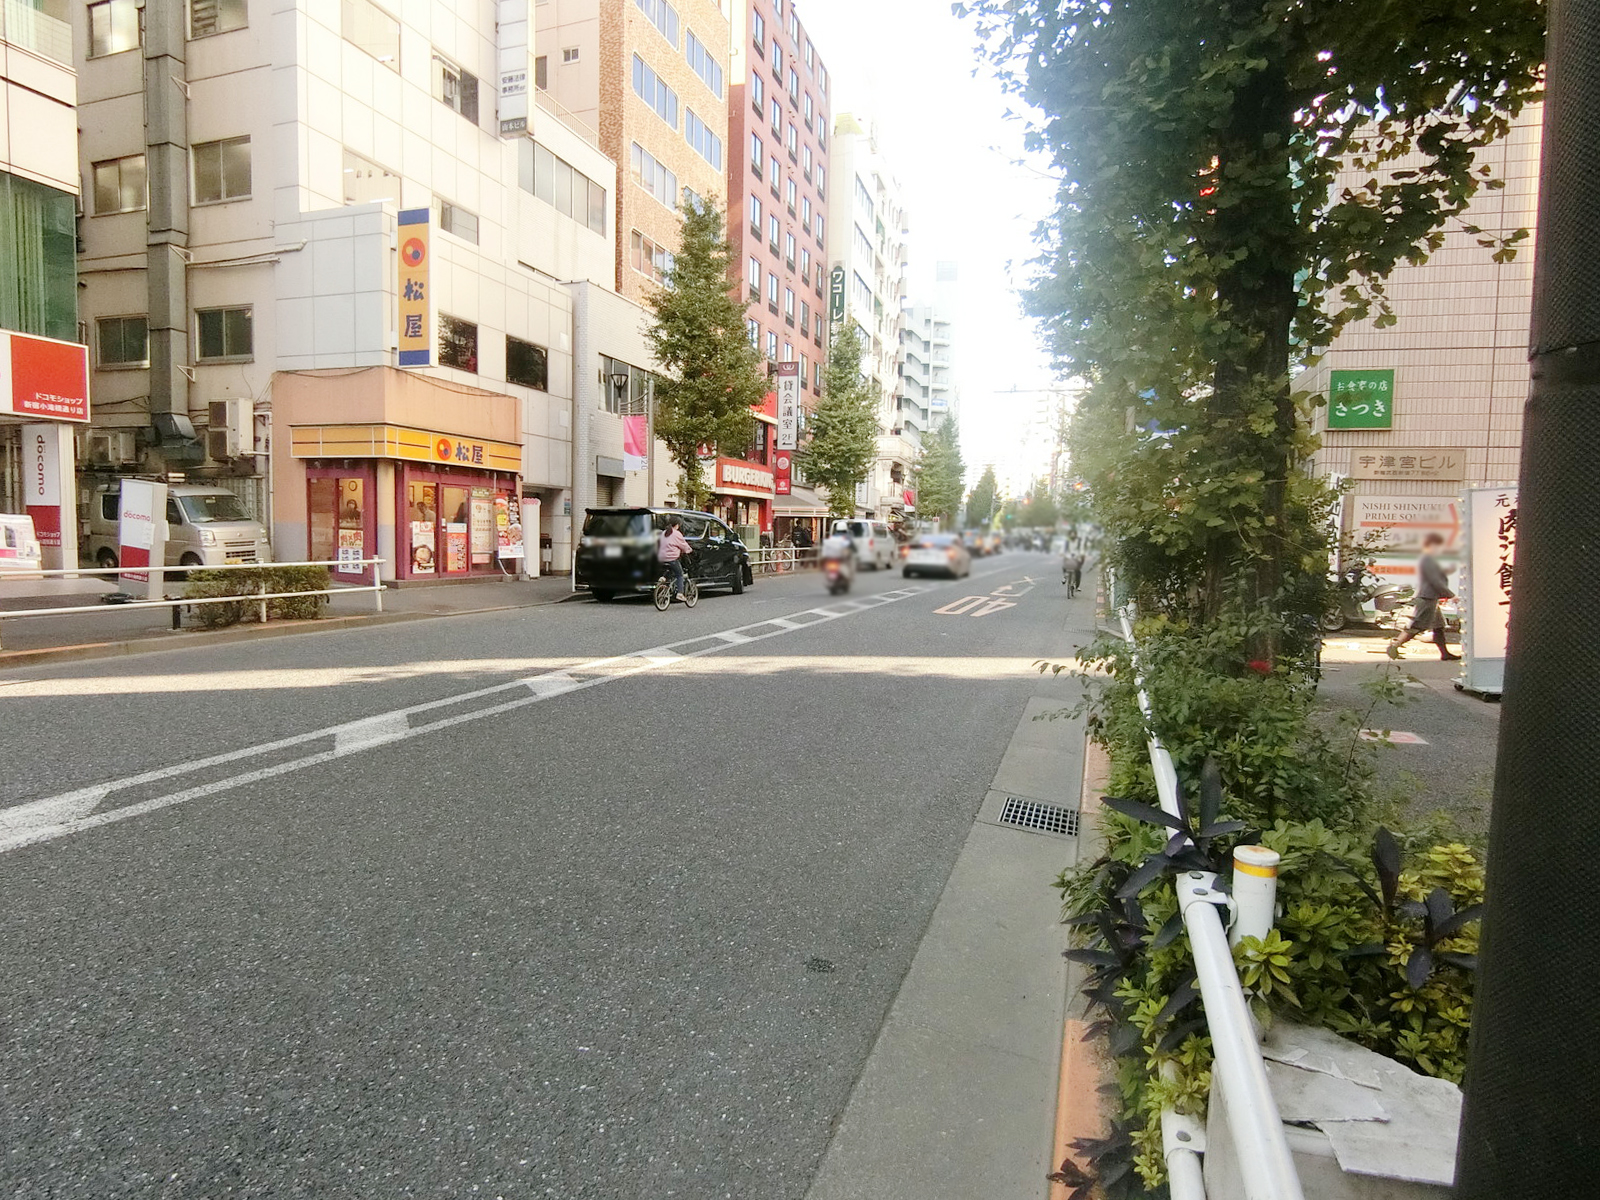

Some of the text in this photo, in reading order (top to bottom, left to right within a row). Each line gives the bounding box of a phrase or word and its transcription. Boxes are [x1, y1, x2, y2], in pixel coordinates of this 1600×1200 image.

[502, 121, 526, 131] 山本ビル
[403, 278, 425, 338] 松屋
[1337, 380, 1388, 391] お食事の店
[35, 392, 84, 405] ドコモショップ
[782, 380, 793, 429] 貸会議室
[1335, 399, 1386, 417] さつき
[782, 433, 793, 441] 2F
[455, 441, 484, 465] 松屋
[37, 434, 45, 496] docomo
[1358, 455, 1456, 469] 宇津宮ビル
[722, 464, 760, 486] BURGER
[1362, 502, 1446, 511] NISHI SHINJUKU
[123, 511, 151, 522] docomo
